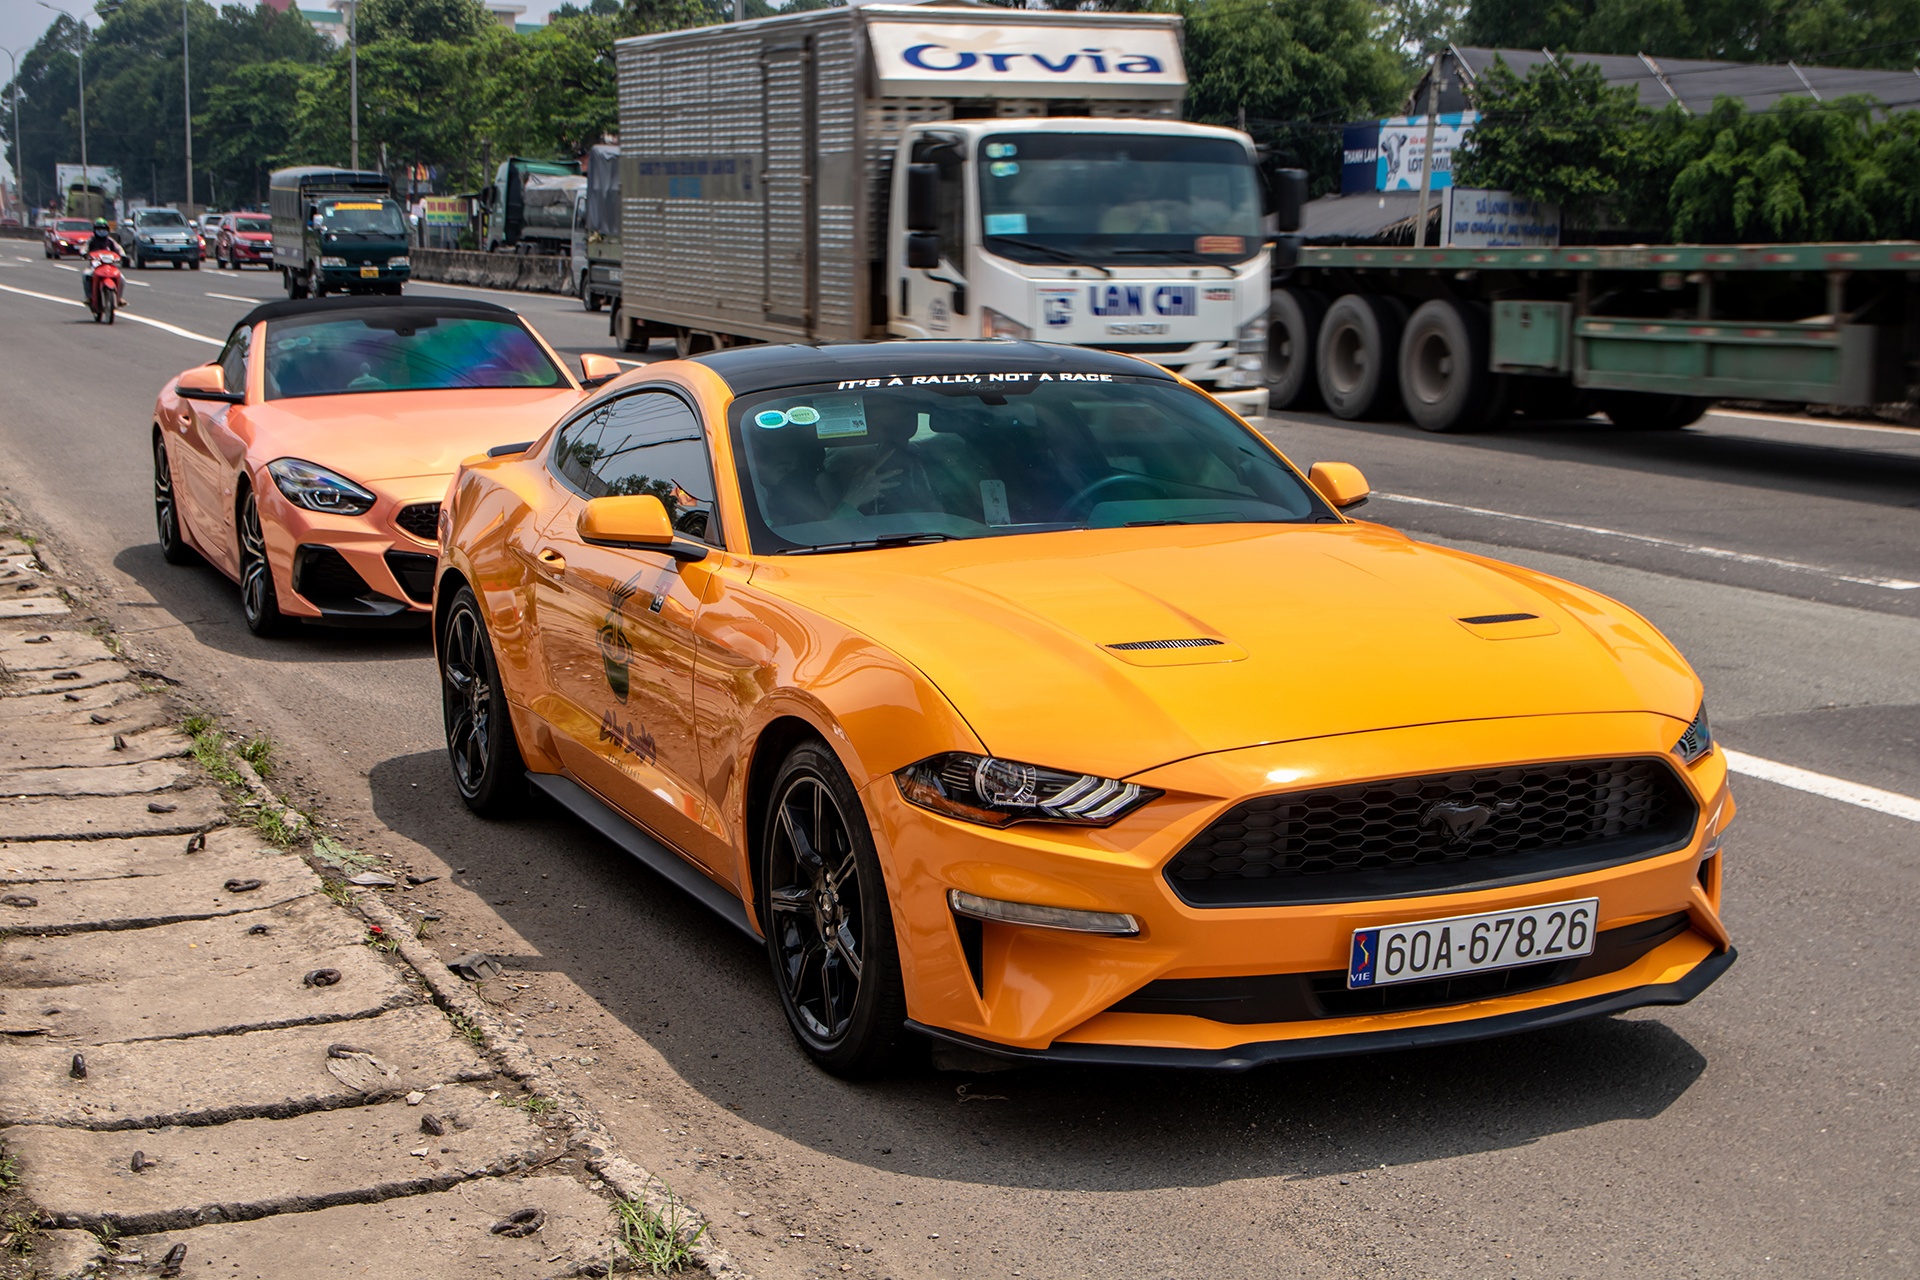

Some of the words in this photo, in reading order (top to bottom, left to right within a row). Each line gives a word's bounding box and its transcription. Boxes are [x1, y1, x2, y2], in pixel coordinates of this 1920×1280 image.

[902, 43, 1165, 74] Orvia
[837, 378, 881, 390] IT'S
[887, 377, 904, 387] A
[911, 373, 982, 385] RALLY,
[989, 373, 1033, 382] NOT
[1039, 373, 1054, 382] A
[1060, 373, 1113, 383] RACE
[1385, 909, 1589, 976] 60A-678.26
[1350, 971, 1370, 982] VIE
